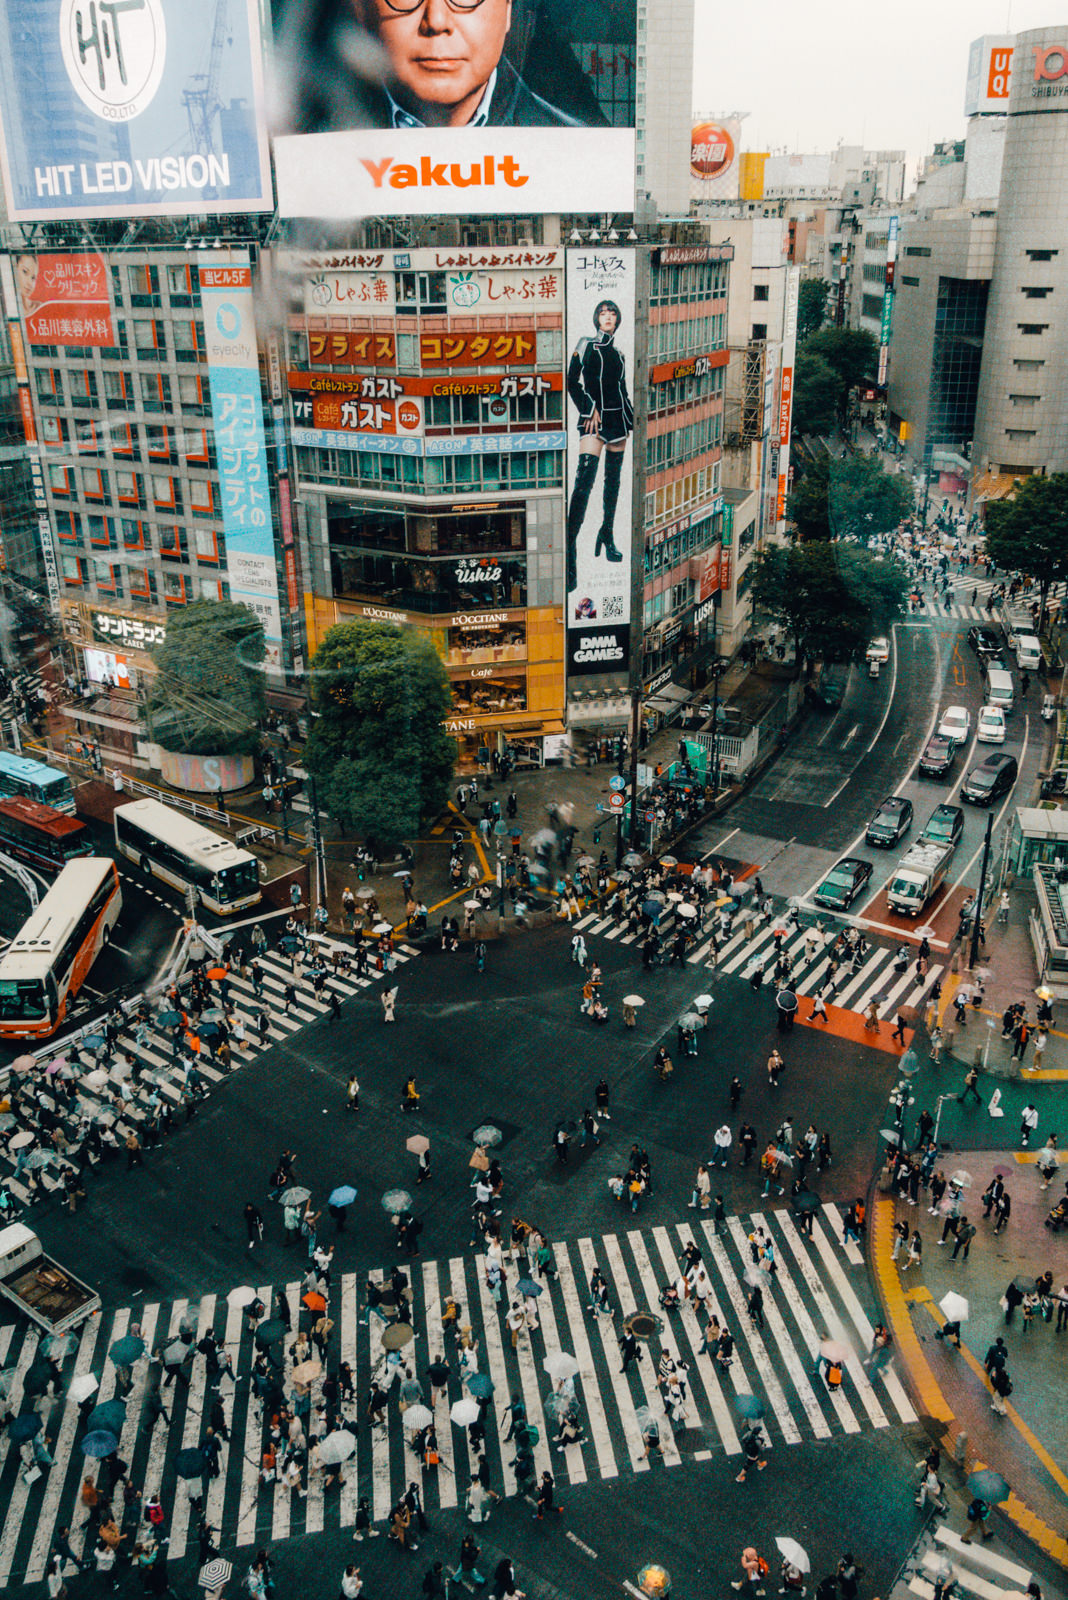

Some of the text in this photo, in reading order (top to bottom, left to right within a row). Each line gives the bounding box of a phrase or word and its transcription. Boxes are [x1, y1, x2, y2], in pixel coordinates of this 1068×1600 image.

[35, 153, 231, 197] HIT LED VISION
[359, 155, 529, 189] Yakult
[55, 263, 101, 277] 品川スキン
[436, 252, 557, 267] しゃぶしゃぶバイキング
[57, 280, 98, 294] クリニック
[204, 270, 245, 285] 当ビル5F
[488, 275, 558, 300] しゃぶ葉
[335, 279, 388, 302] しゃぶ葉
[38, 318, 109, 338] 品川美容外科
[310, 336, 394, 358] プライス
[421, 335, 532, 359] コンタクト
[362, 376, 402, 399] ガスト
[500, 376, 551, 398] ガスト
[294, 401, 313, 418] 7F
[341, 401, 392, 429] ガスト
[401, 413, 419, 423] ガスト
[326, 432, 399, 451] 英会話イーオン
[470, 434, 563, 451] 英会話イーオン
[216, 393, 247, 524] アイシティ
[240, 394, 266, 527] コンタクトの
[455, 566, 502, 583] Ushi8
[452, 613, 508, 626] L'OCCITANE
[694, 598, 714, 625] LUSH
[97, 614, 166, 644] サンドラッグ
[580, 635, 617, 650] DMM
[573, 647, 624, 663] GAMES
